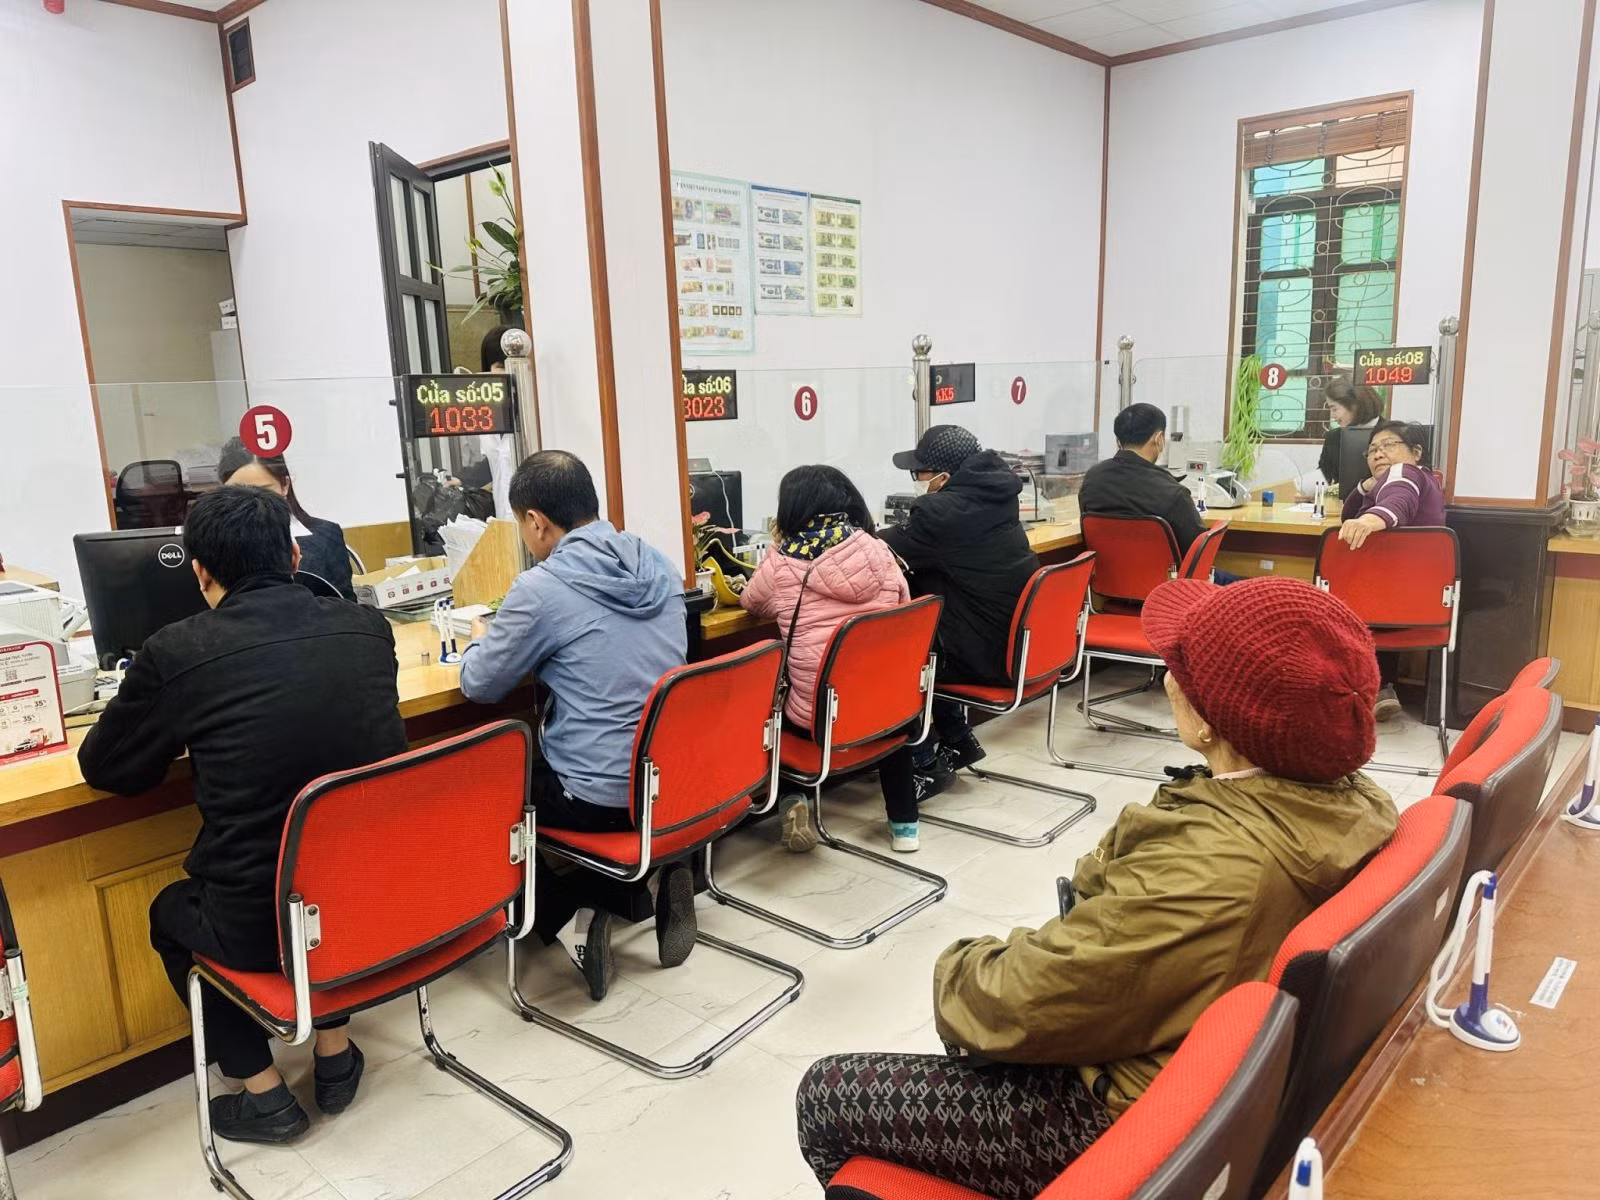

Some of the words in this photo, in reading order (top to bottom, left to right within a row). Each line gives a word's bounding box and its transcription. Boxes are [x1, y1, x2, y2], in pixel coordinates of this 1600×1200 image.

[1267, 367, 1279, 386] 8
[1365, 367, 1413, 384] 1049
[455, 381, 504, 403] số:05
[1016, 381, 1023, 401] 7
[801, 391, 811, 416] 6
[430, 406, 494, 433] 1033
[254, 413, 278, 450] 5
[161, 551, 182, 560] DELL
